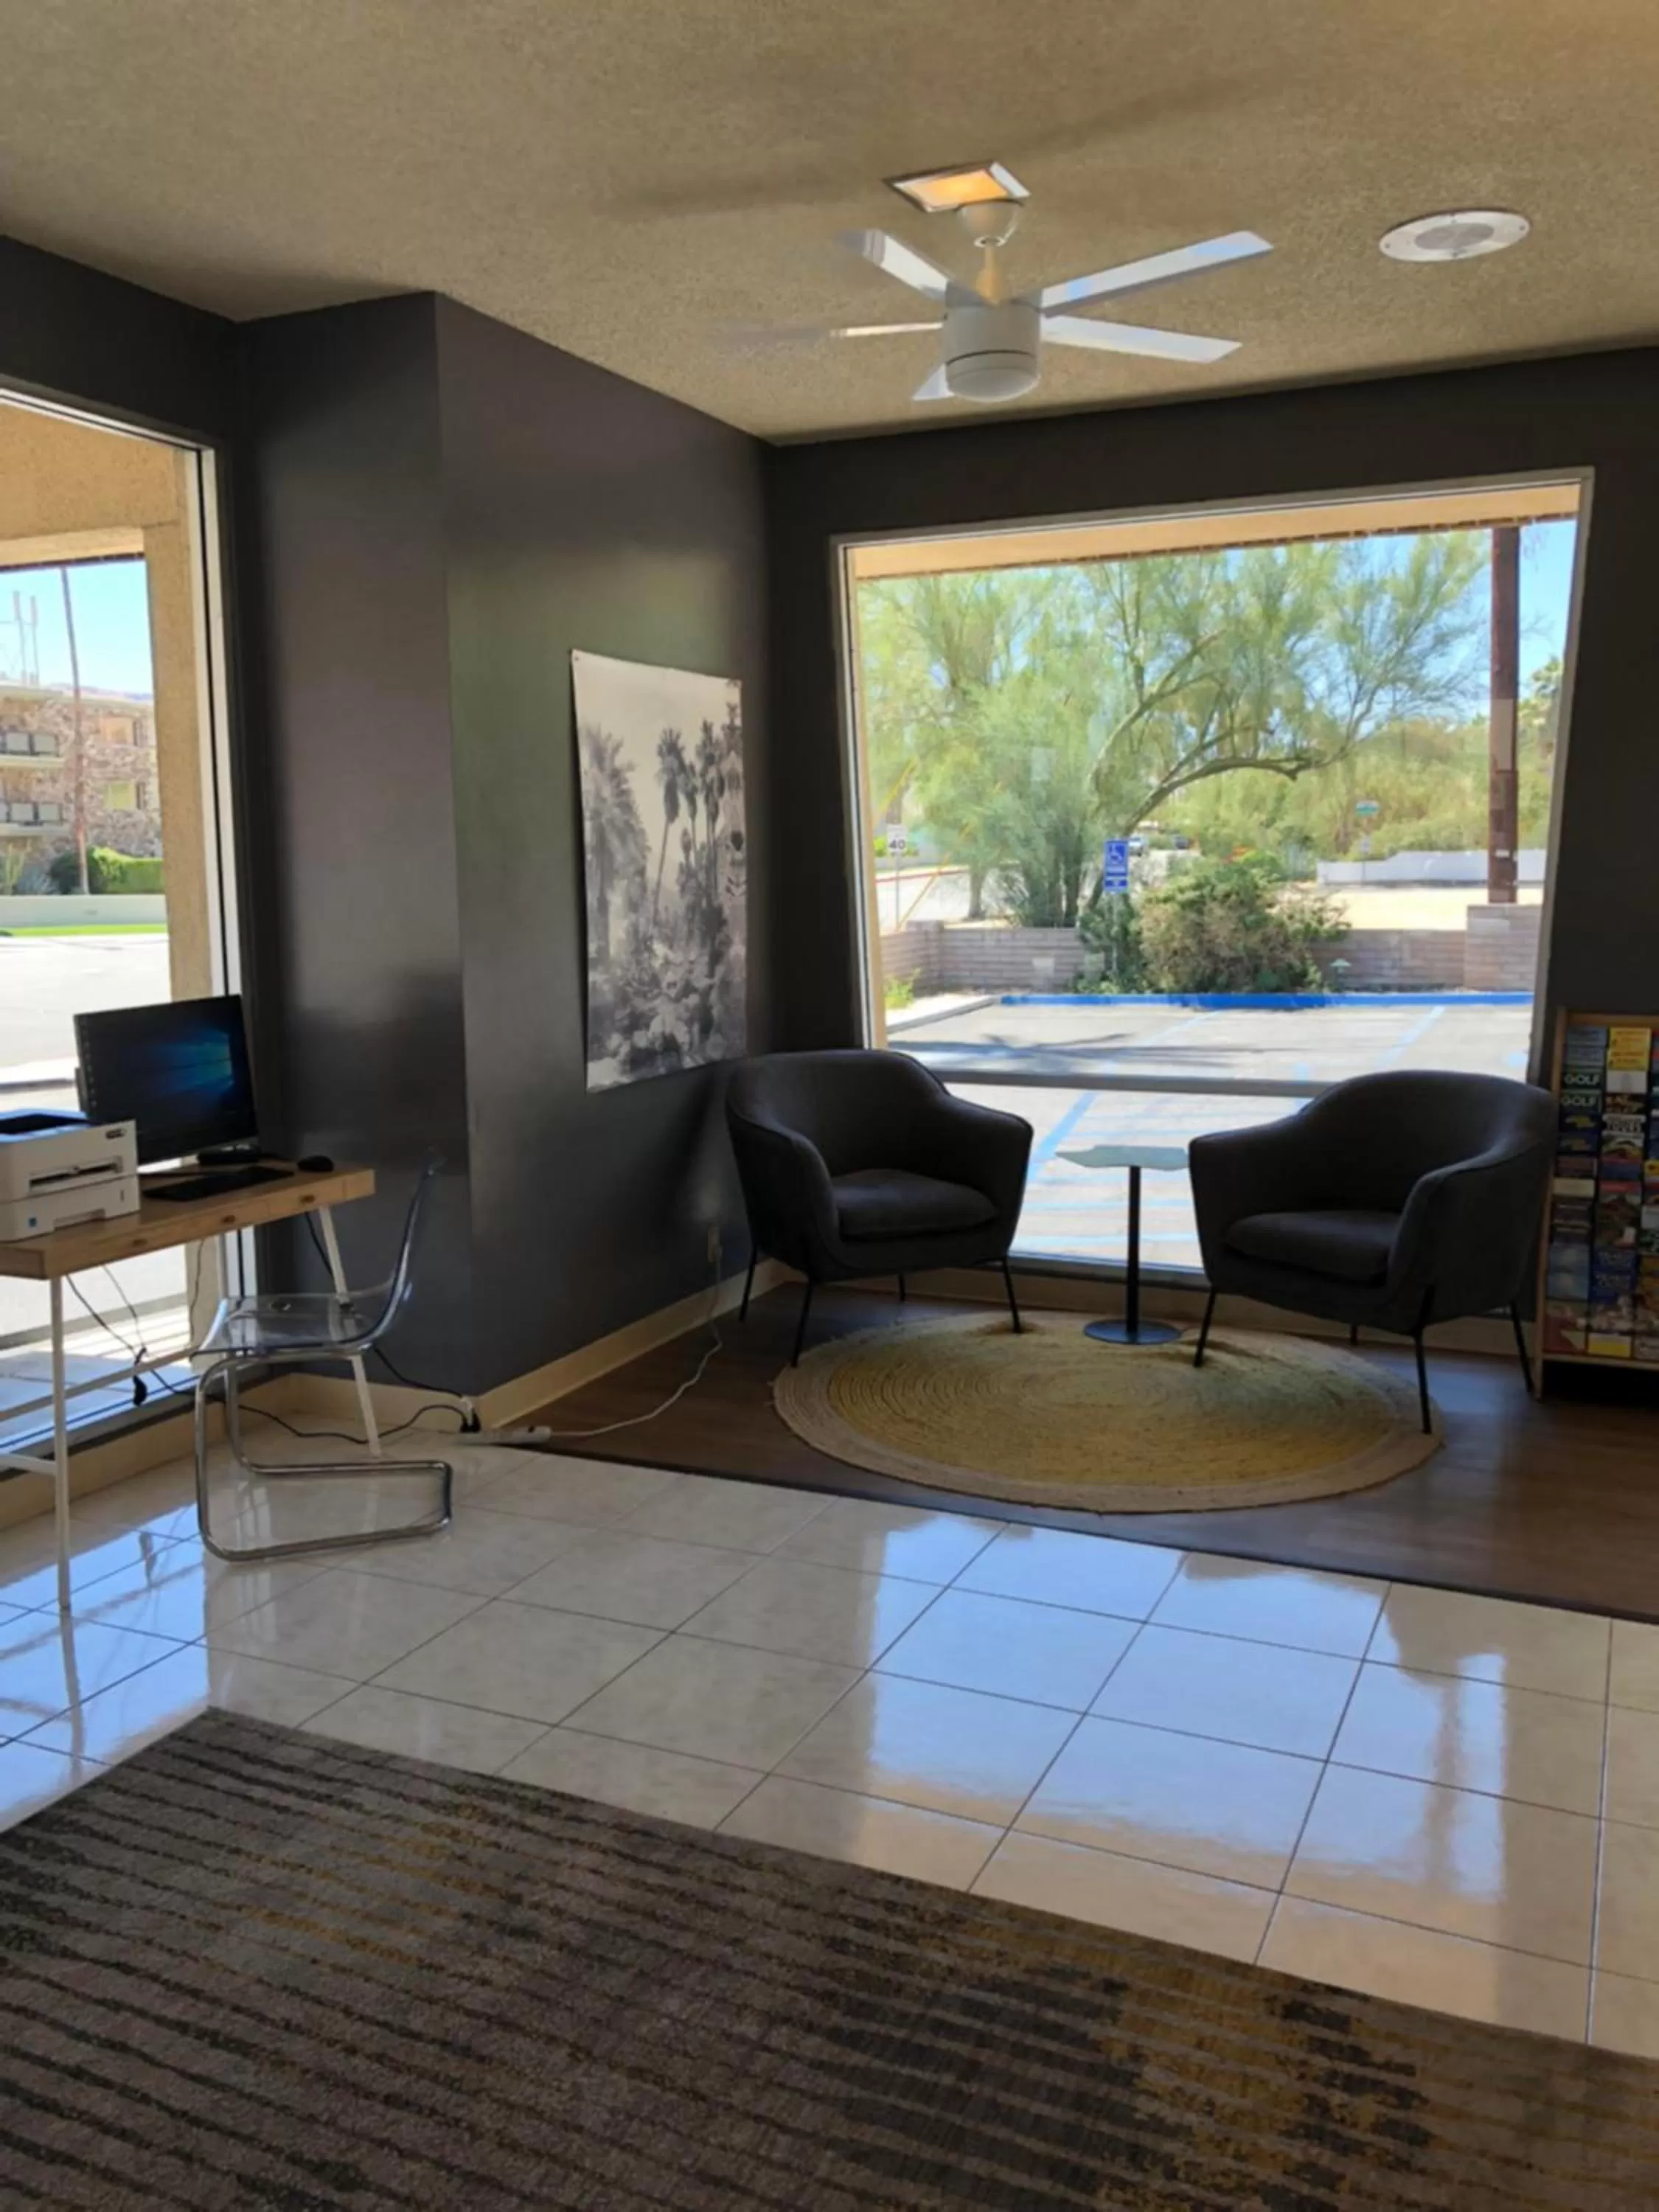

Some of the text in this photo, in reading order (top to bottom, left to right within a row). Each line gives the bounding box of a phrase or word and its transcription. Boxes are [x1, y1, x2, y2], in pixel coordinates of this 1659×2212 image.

[889, 839, 905, 850] 40
[1564, 1073, 1600, 1086] GOLF
[1561, 1095, 1596, 1107] GOLF
